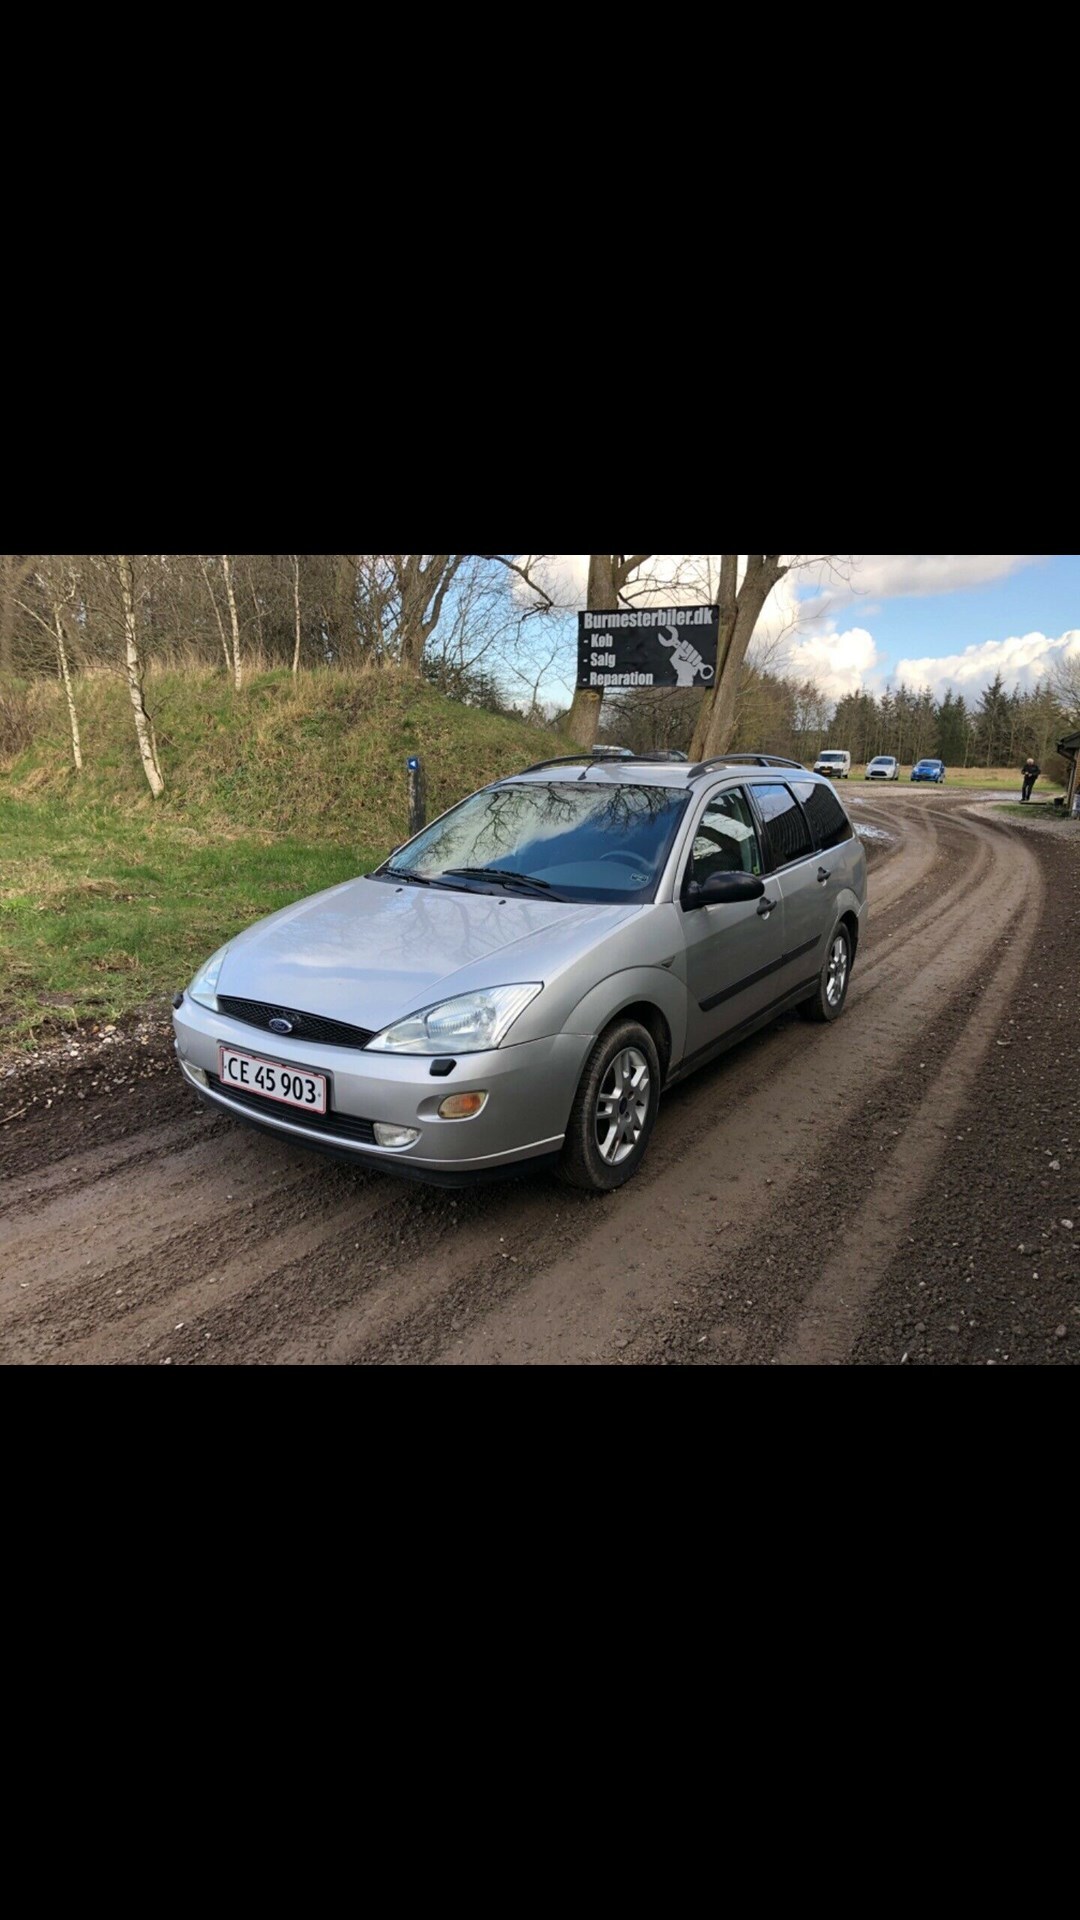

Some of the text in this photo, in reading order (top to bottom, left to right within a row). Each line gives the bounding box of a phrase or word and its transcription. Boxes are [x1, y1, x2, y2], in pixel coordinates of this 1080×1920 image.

[584, 607, 713, 629] Burmesterbiler.dk
[590, 652, 616, 668] Salg
[590, 671, 653, 687] Reparation
[228, 1057, 315, 1104] CE 45 903
